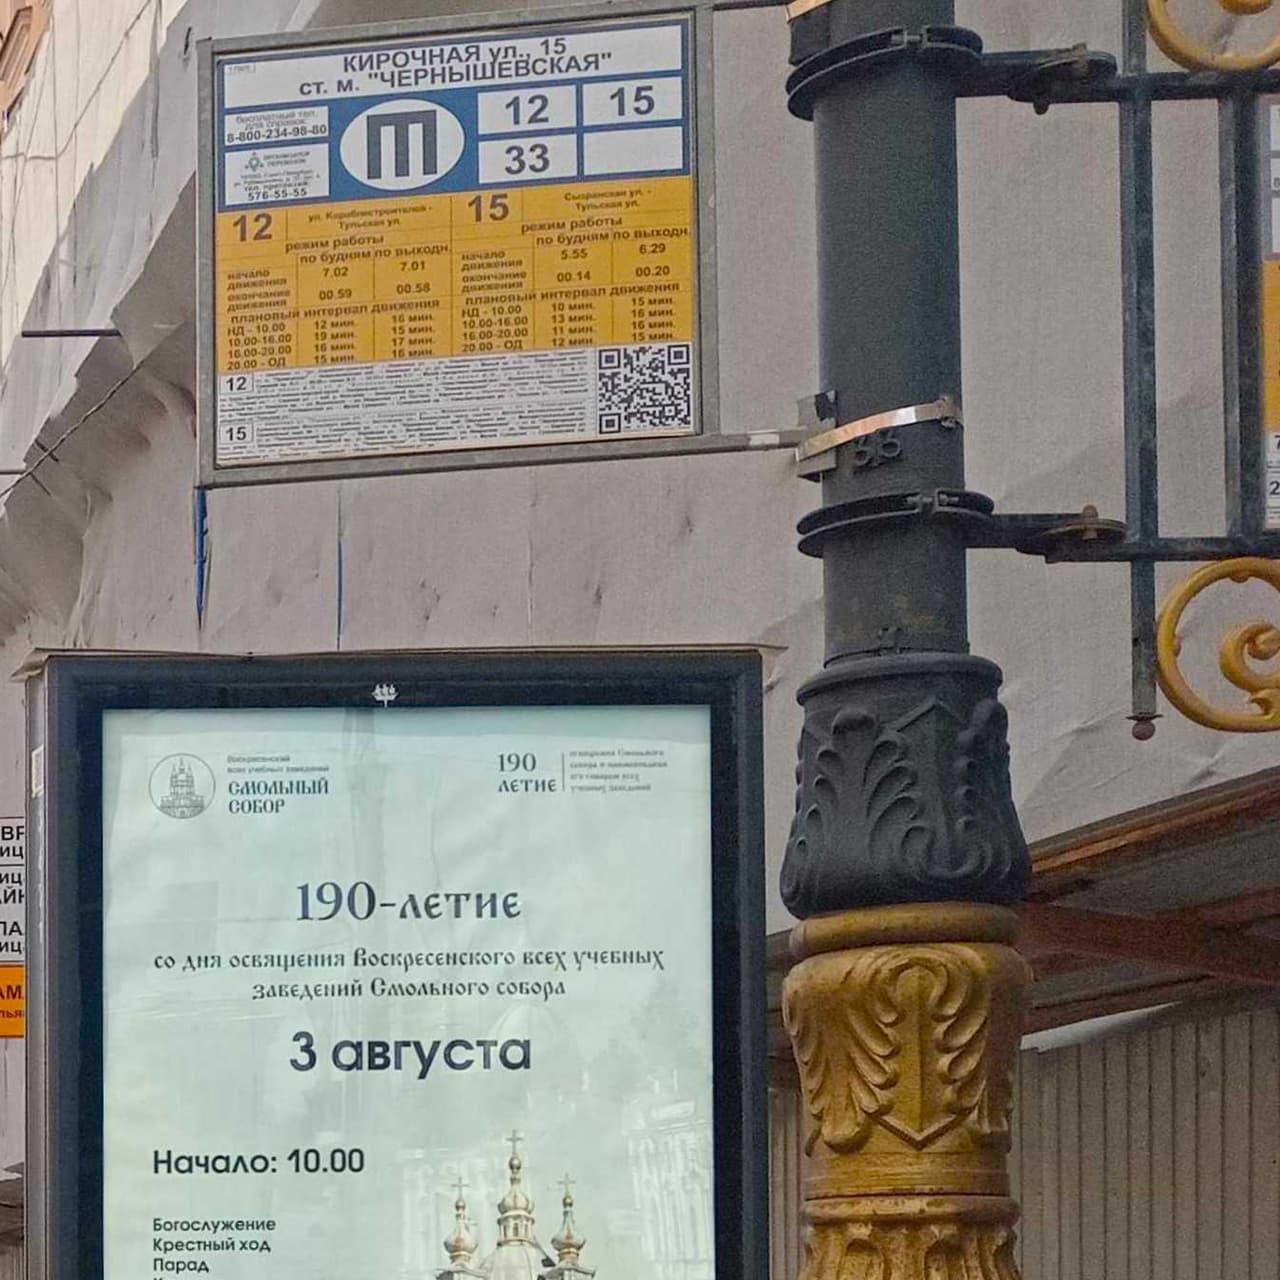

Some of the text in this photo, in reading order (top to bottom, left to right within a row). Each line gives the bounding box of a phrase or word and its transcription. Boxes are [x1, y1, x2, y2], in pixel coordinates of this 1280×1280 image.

[343, 37, 567, 73] КИРОЧНАЯ ул., 15
[368, 52, 612, 88] "ЧЕРНЫШЕВСКАЯ"
[505, 85, 655, 125] 12 15
[505, 143, 550, 175] 33
[468, 193, 509, 223] 15
[233, 212, 273, 242] 12
[521, 217, 622, 235] режим работы
[285, 235, 384, 253] режим работы
[536, 236, 553, 246] по
[613, 230, 630, 241] по
[300, 254, 317, 264] по
[320, 251, 371, 264] будням
[375, 248, 391, 259] по
[561, 243, 666, 260] 5.55 6.29
[323, 261, 426, 278] 7.02 7.01
[556, 266, 670, 282] 00.14 00.20
[319, 288, 352, 300] 00.59
[541, 287, 606, 300] интервал
[609, 282, 680, 297] движения
[304, 305, 368, 319] интервал
[371, 299, 440, 314] движения
[491, 305, 522, 315] 10.00
[256, 323, 286, 334] 10.00
[226, 376, 247, 392] 12
[226, 426, 247, 441] 15
[498, 752, 537, 773] 190
[228, 777, 329, 795] СМОЛЬНЫЙ
[228, 798, 285, 814] СОБОР
[296, 880, 522, 922] 190-летие
[154, 947, 665, 973] со дня освящения Воскресенского всех учебных
[252, 977, 566, 1002] заведений Смольного собора
[289, 1031, 532, 1079] 3 августа
[153, 1148, 366, 1176] Начало: 10.00
[152, 1217, 277, 1236] Богослужение
[152, 1236, 271, 1255] Крестный ход
[152, 1259, 210, 1274] Парад
